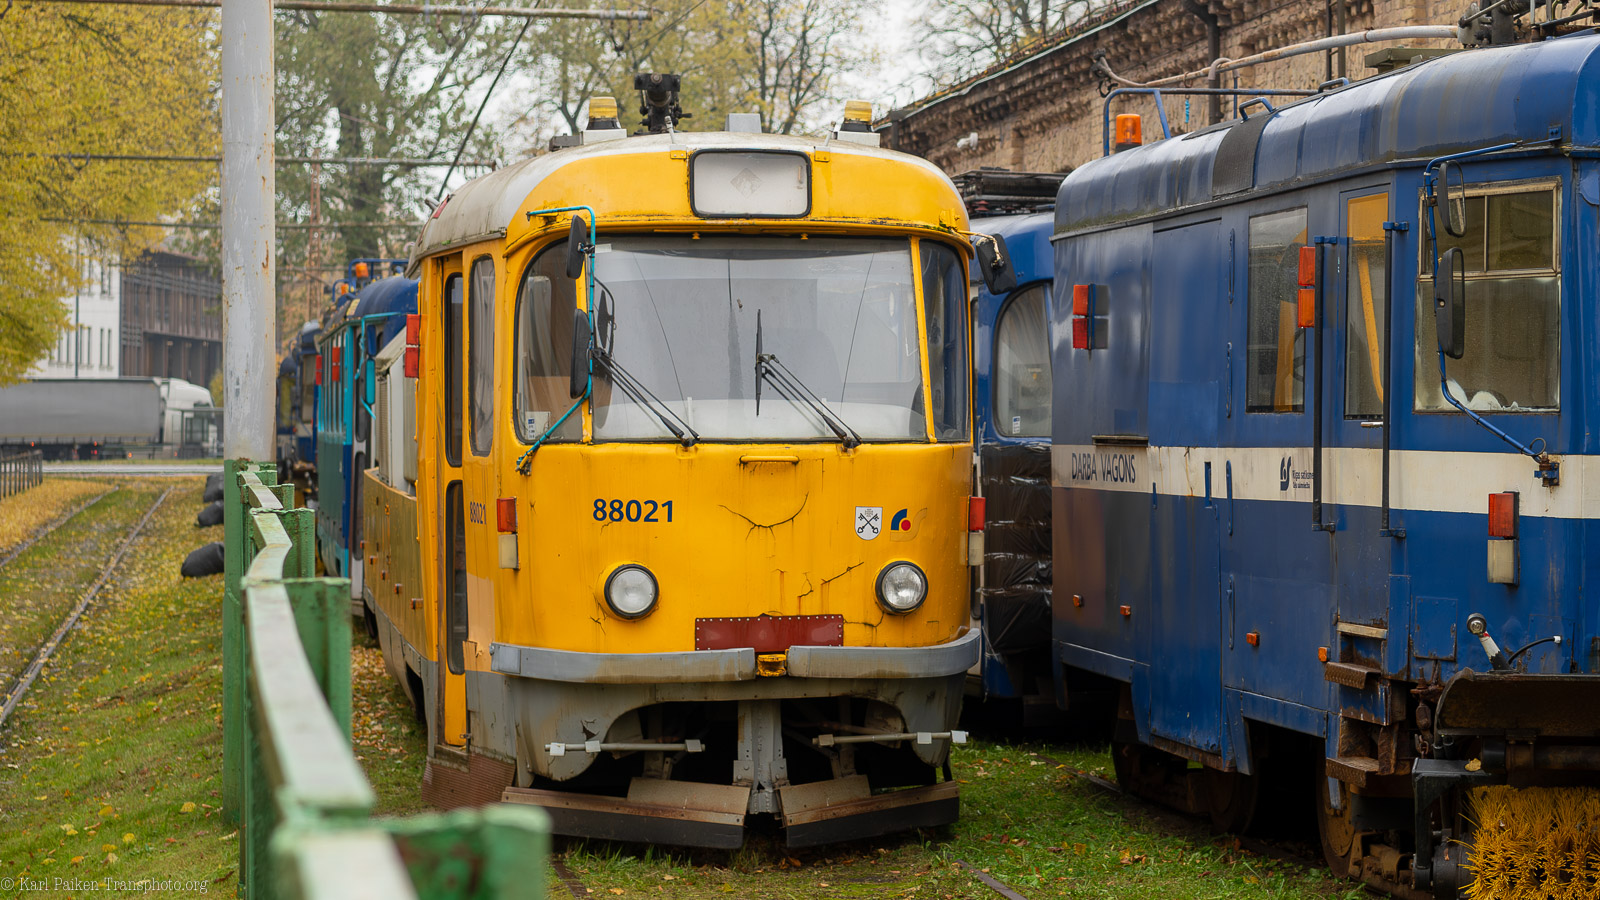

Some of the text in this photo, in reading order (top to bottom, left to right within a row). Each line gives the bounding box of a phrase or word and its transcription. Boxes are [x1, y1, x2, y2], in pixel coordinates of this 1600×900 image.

[1072, 452, 1136, 484] DARBA VAGONS
[470, 501, 487, 525] 88021
[592, 498, 673, 523] 88021
